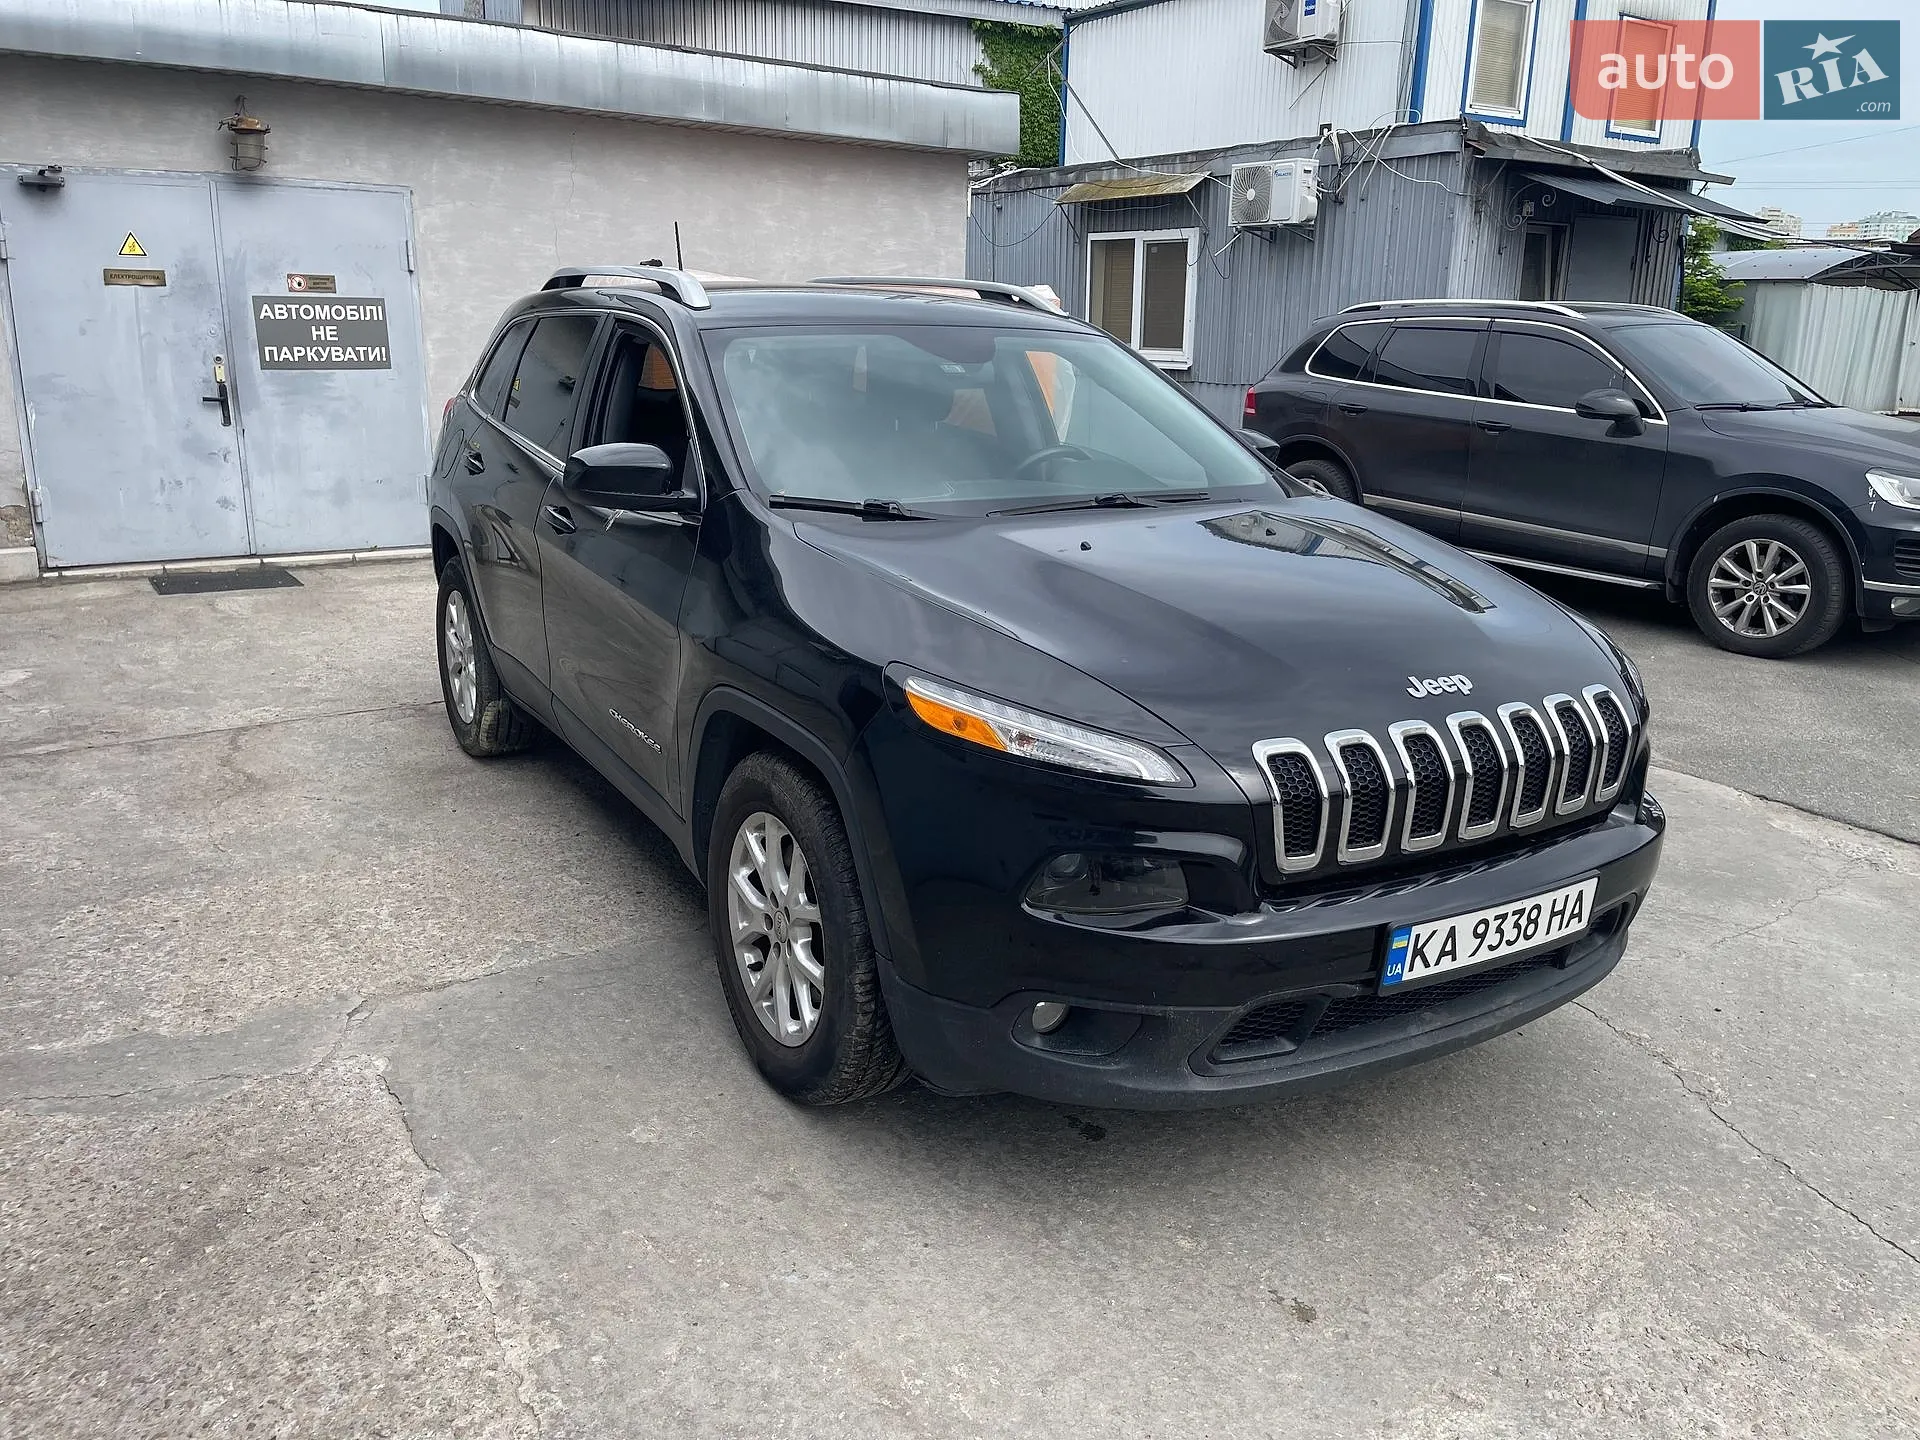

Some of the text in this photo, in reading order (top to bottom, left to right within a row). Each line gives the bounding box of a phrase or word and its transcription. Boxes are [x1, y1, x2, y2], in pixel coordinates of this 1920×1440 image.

[259, 303, 384, 321] АВТОМОБІЛІ
[311, 325, 339, 341] НЕ
[264, 346, 388, 362] ПАРКУВАТИ!
[1406, 674, 1473, 699] Jeep
[1407, 889, 1586, 973] KA 9338 HA
[1386, 962, 1403, 977] UA
